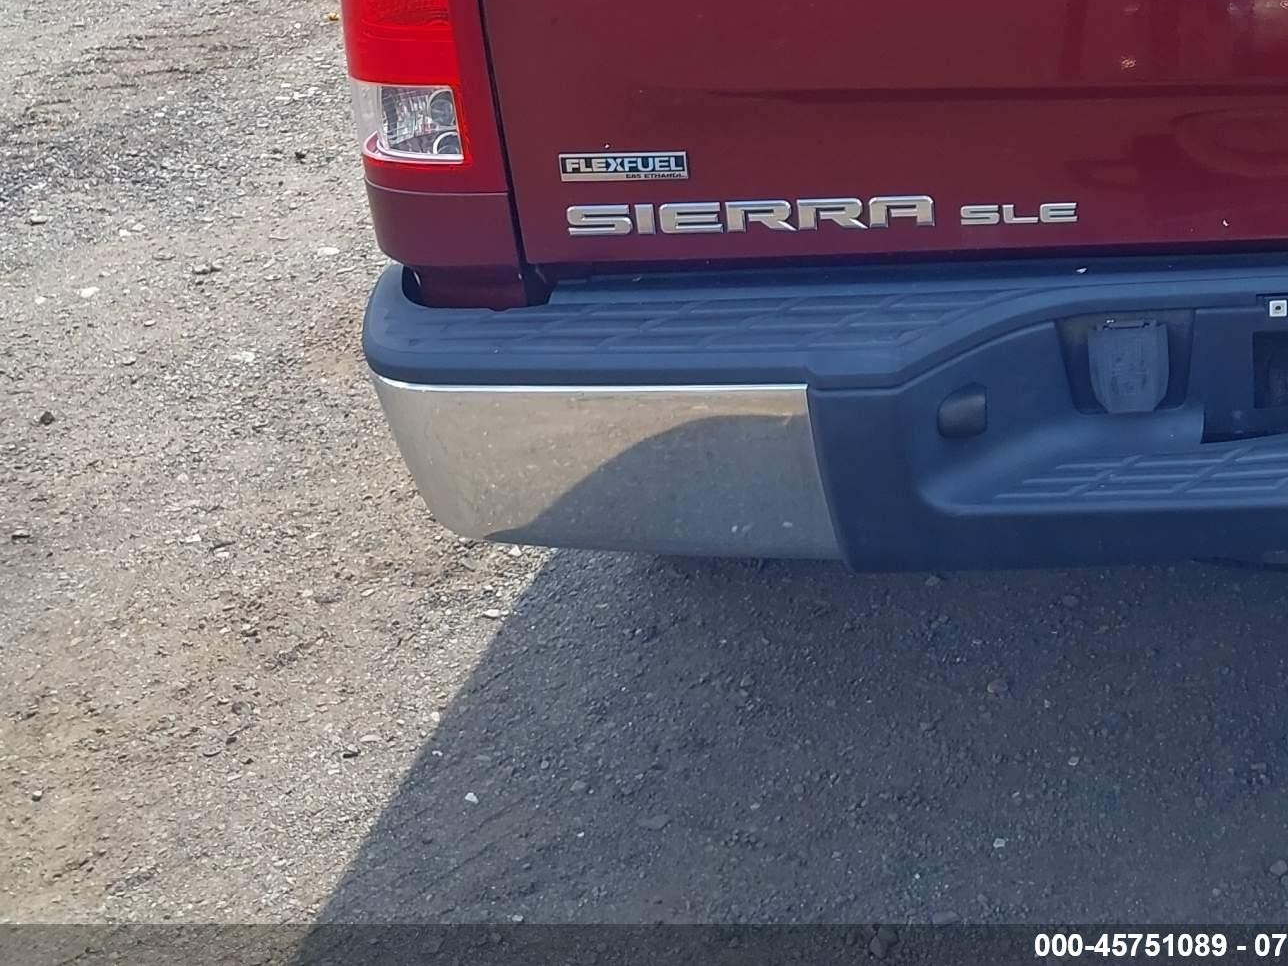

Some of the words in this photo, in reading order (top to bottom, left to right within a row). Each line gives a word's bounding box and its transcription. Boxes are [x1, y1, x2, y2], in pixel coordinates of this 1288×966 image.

[565, 156, 683, 172] FLEXFUEL
[566, 195, 935, 235] SIERRA
[960, 202, 1078, 225] SLE
